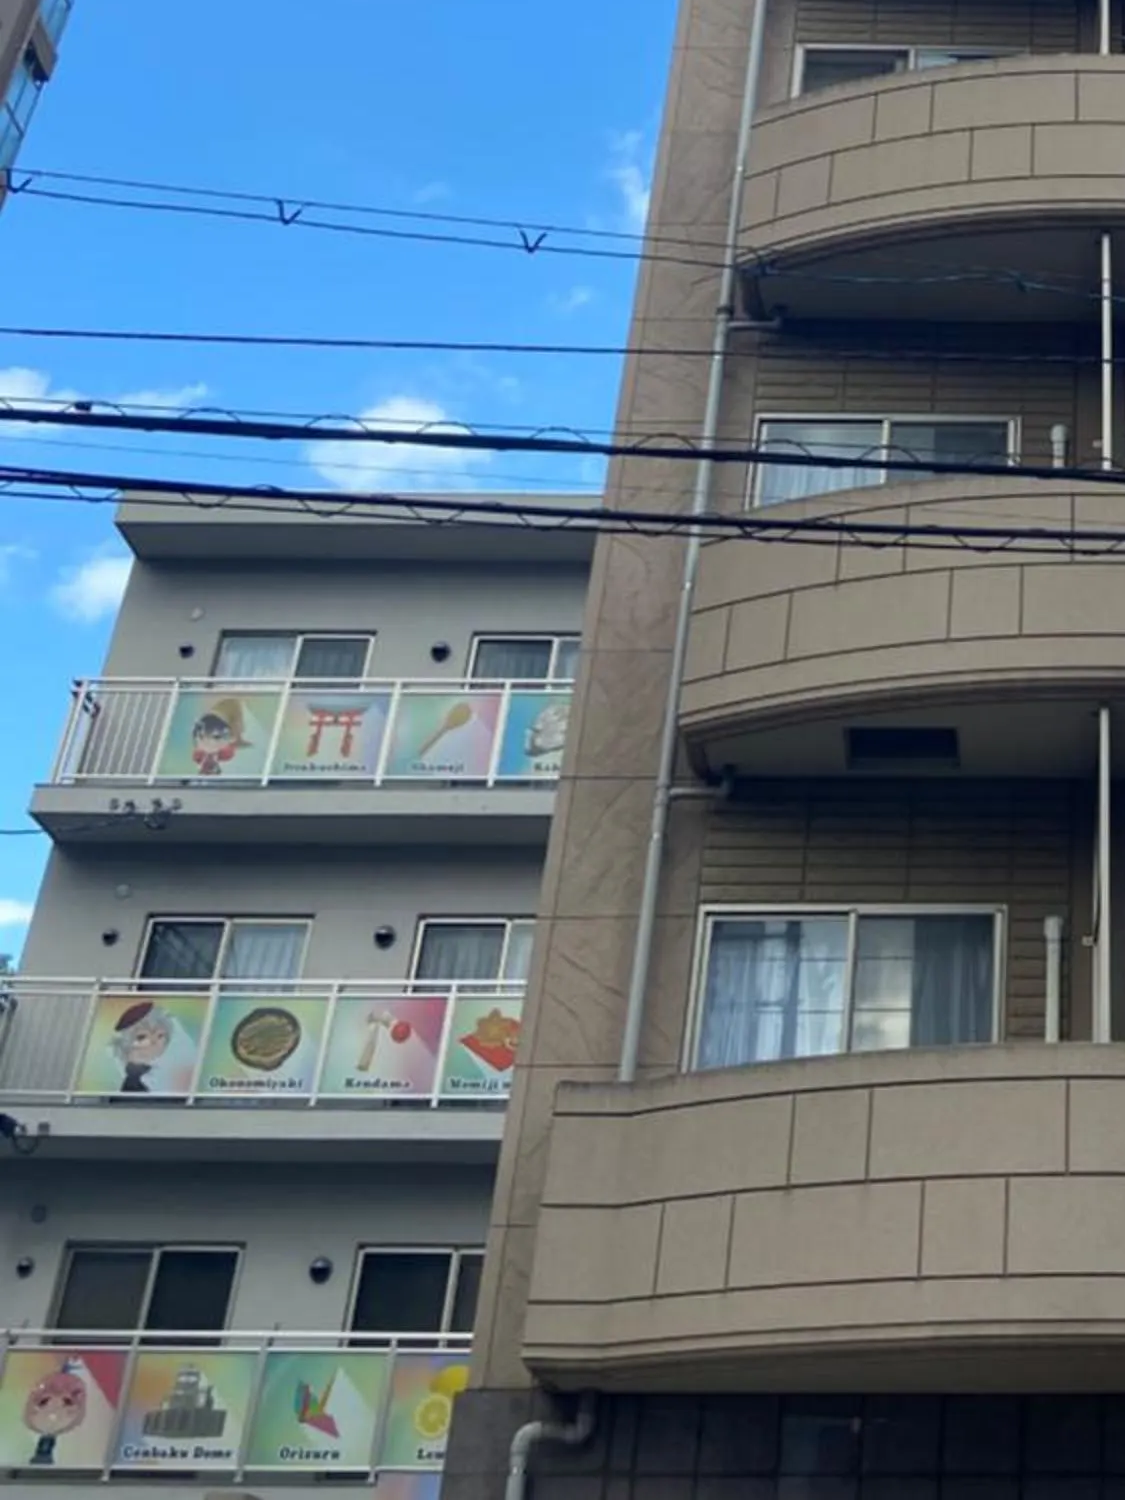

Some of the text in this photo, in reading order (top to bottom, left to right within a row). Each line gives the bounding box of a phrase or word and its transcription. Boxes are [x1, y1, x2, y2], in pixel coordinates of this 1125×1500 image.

[209, 1076, 303, 1089] Okonomiyaki
[344, 1077, 411, 1088] Kendama
[450, 1077, 498, 1090] Momiji
[123, 1445, 232, 1459] Genbaku Dome
[279, 1446, 341, 1460] Orisuru
